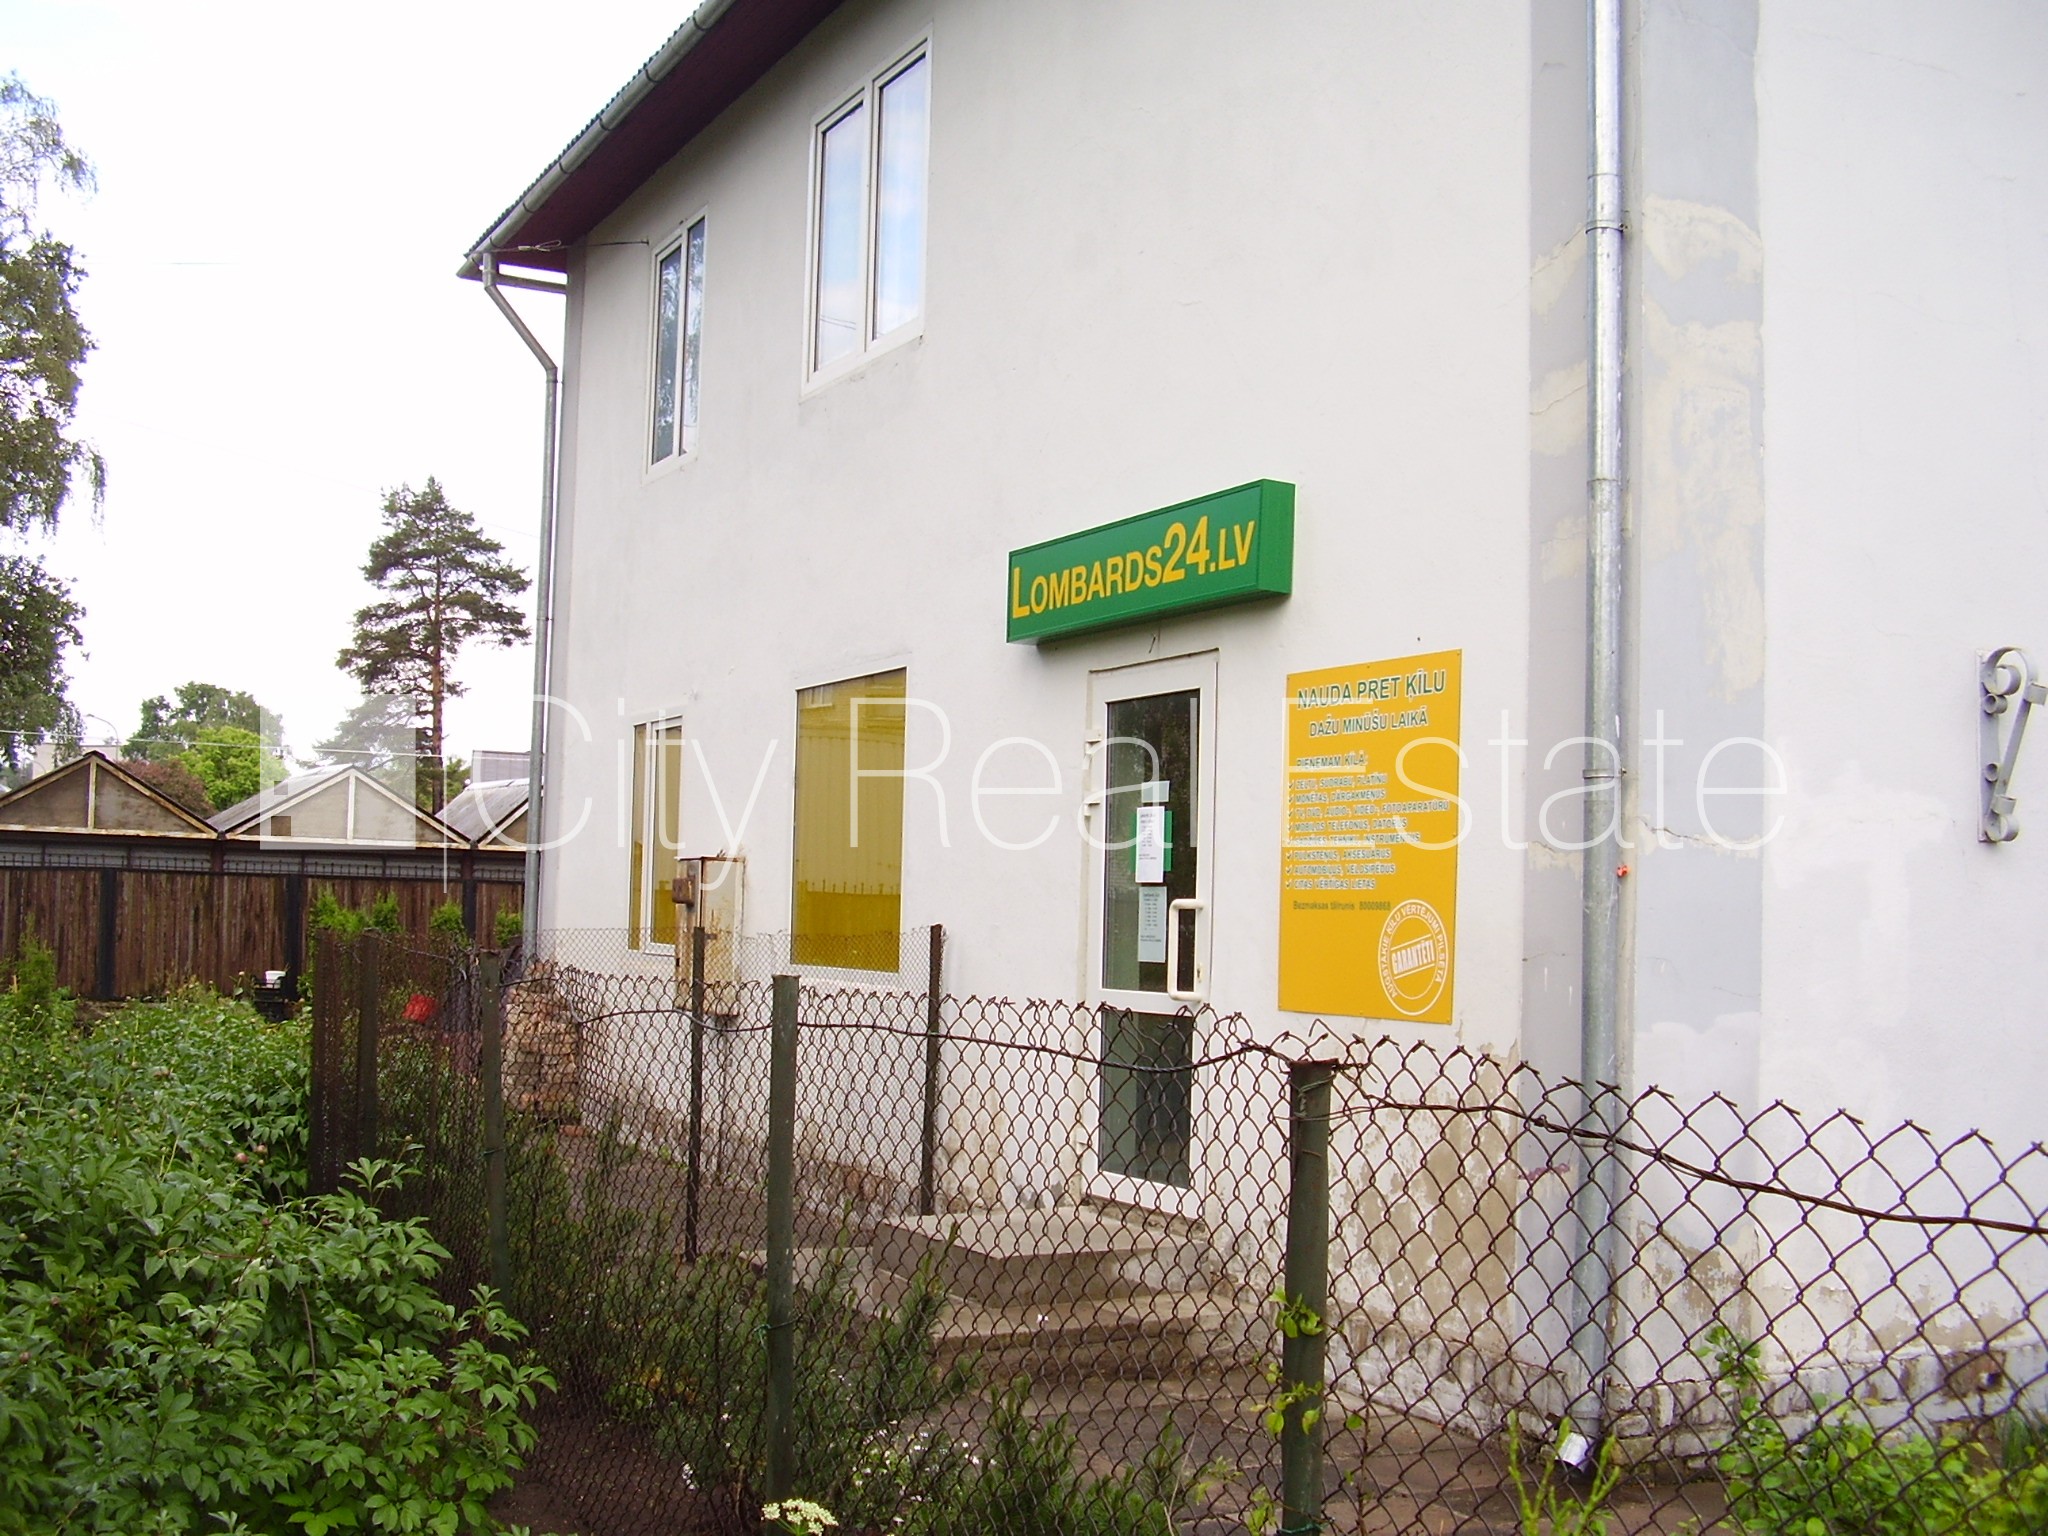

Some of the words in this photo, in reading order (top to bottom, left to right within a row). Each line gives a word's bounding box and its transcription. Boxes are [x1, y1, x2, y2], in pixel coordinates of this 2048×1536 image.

[1297, 684, 1352, 709] NAUDA
[1357, 676, 1400, 702] PRET
[1406, 669, 1446, 700] ĶĪLU
[1309, 714, 1340, 737] DAŽU
[1343, 709, 1387, 734] MINŪŠU
[1391, 706, 1428, 729] LAIKĀ
